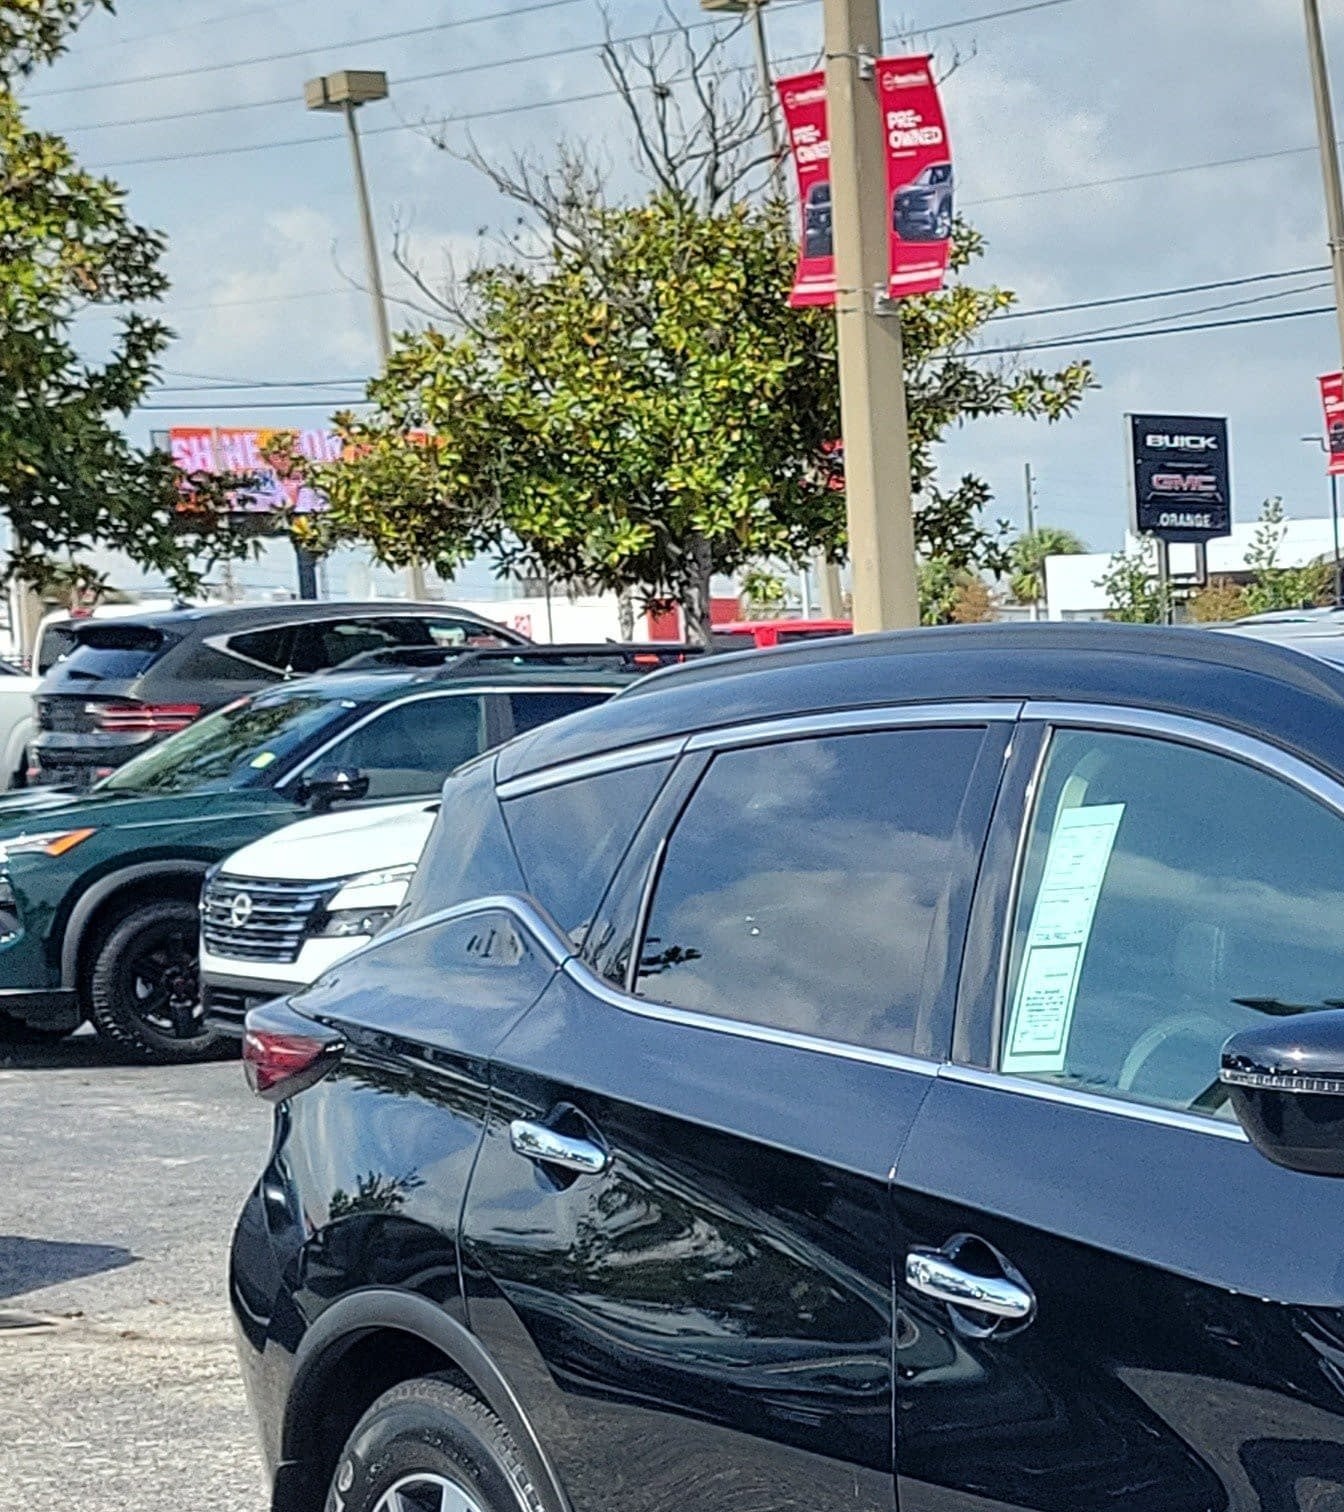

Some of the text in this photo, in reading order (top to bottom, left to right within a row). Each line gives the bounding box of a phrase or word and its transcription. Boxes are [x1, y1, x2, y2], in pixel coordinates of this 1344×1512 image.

[1145, 434, 1218, 450] BUICK
[1152, 473, 1217, 491] GMC
[1159, 513, 1212, 528] ORANGE
